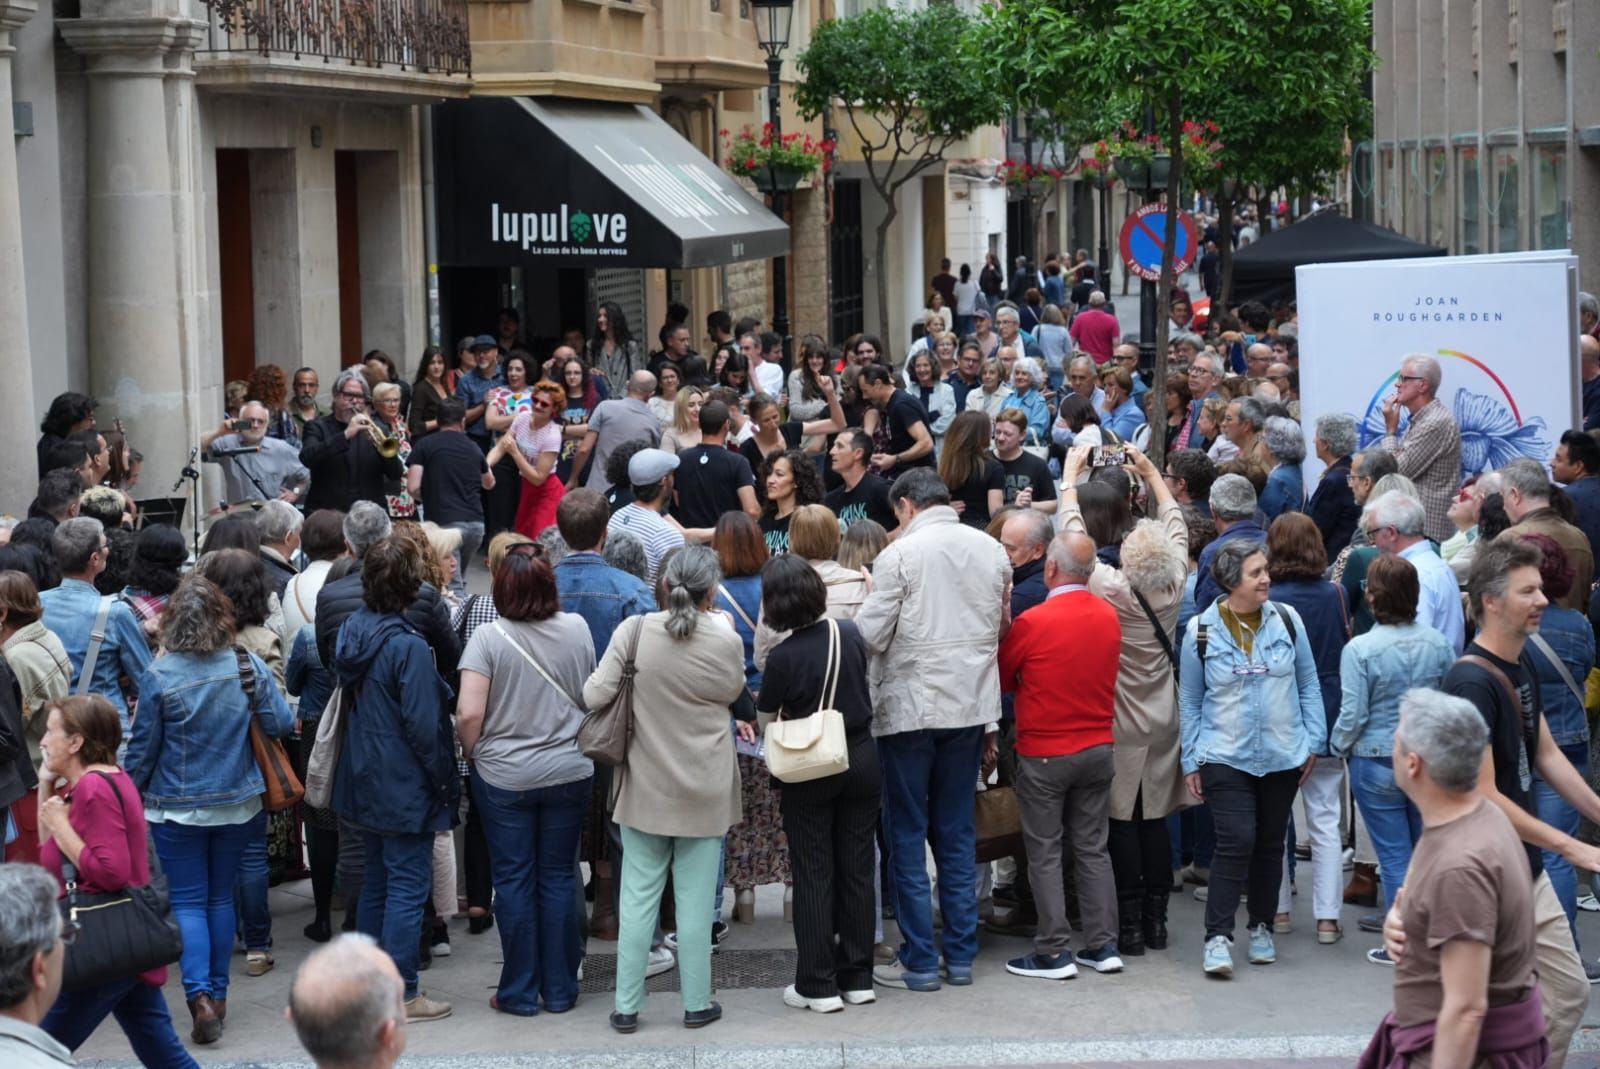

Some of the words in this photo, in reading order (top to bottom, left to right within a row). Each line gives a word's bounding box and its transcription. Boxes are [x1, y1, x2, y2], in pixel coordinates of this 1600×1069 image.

[1136, 203, 1159, 218] AMBOS
[532, 246, 541, 255] La
[543, 247, 560, 255] casa
[561, 246, 570, 255] de
[571, 246, 579, 255] la
[1132, 263, 1141, 275] EN
[1415, 297, 1458, 306] JOAN
[1373, 312, 1502, 322] ROUGHGARDEN
